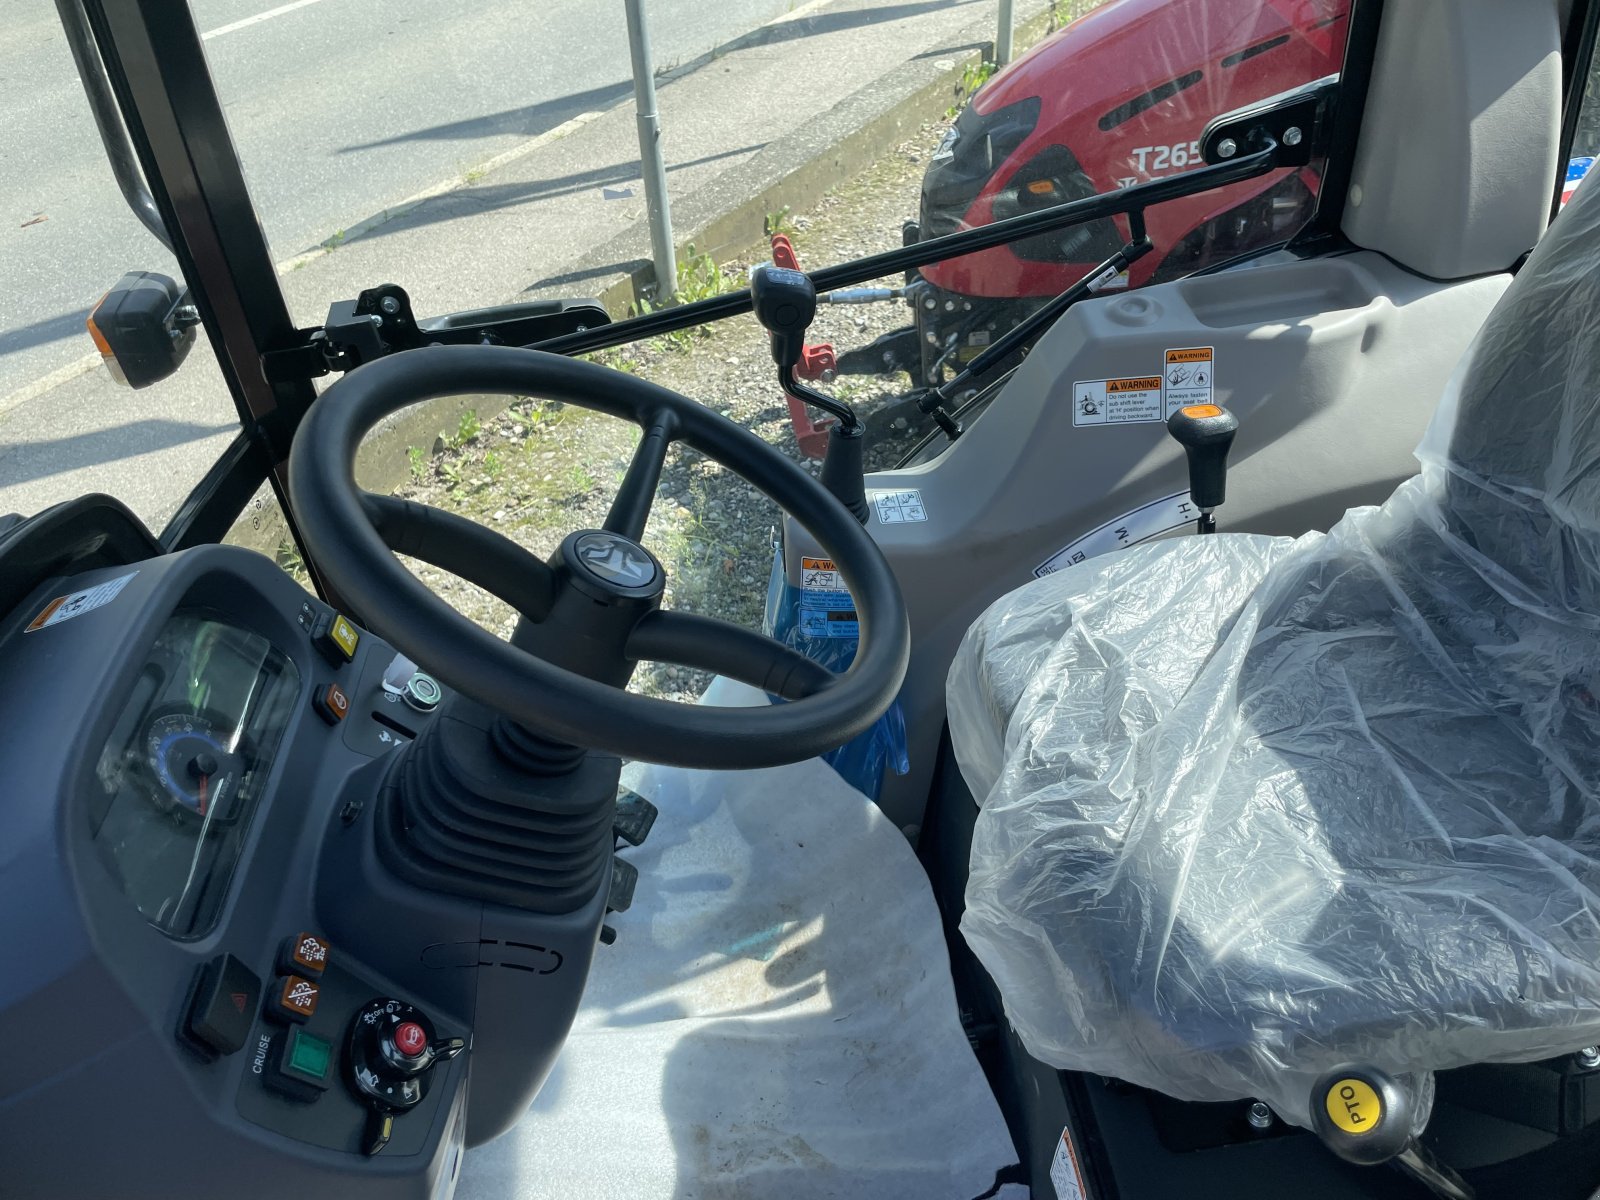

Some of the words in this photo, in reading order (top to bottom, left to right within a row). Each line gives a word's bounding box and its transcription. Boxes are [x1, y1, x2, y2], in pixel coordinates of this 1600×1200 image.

[1132, 141, 1203, 171] T265
[1120, 379, 1159, 390] WARNING
[1177, 502, 1191, 514] H
[1115, 526, 1129, 541] M
[374, 1008, 385, 1017] OFF
[252, 1034, 271, 1074] CRUISE
[1340, 1086, 1366, 1124] PTO
